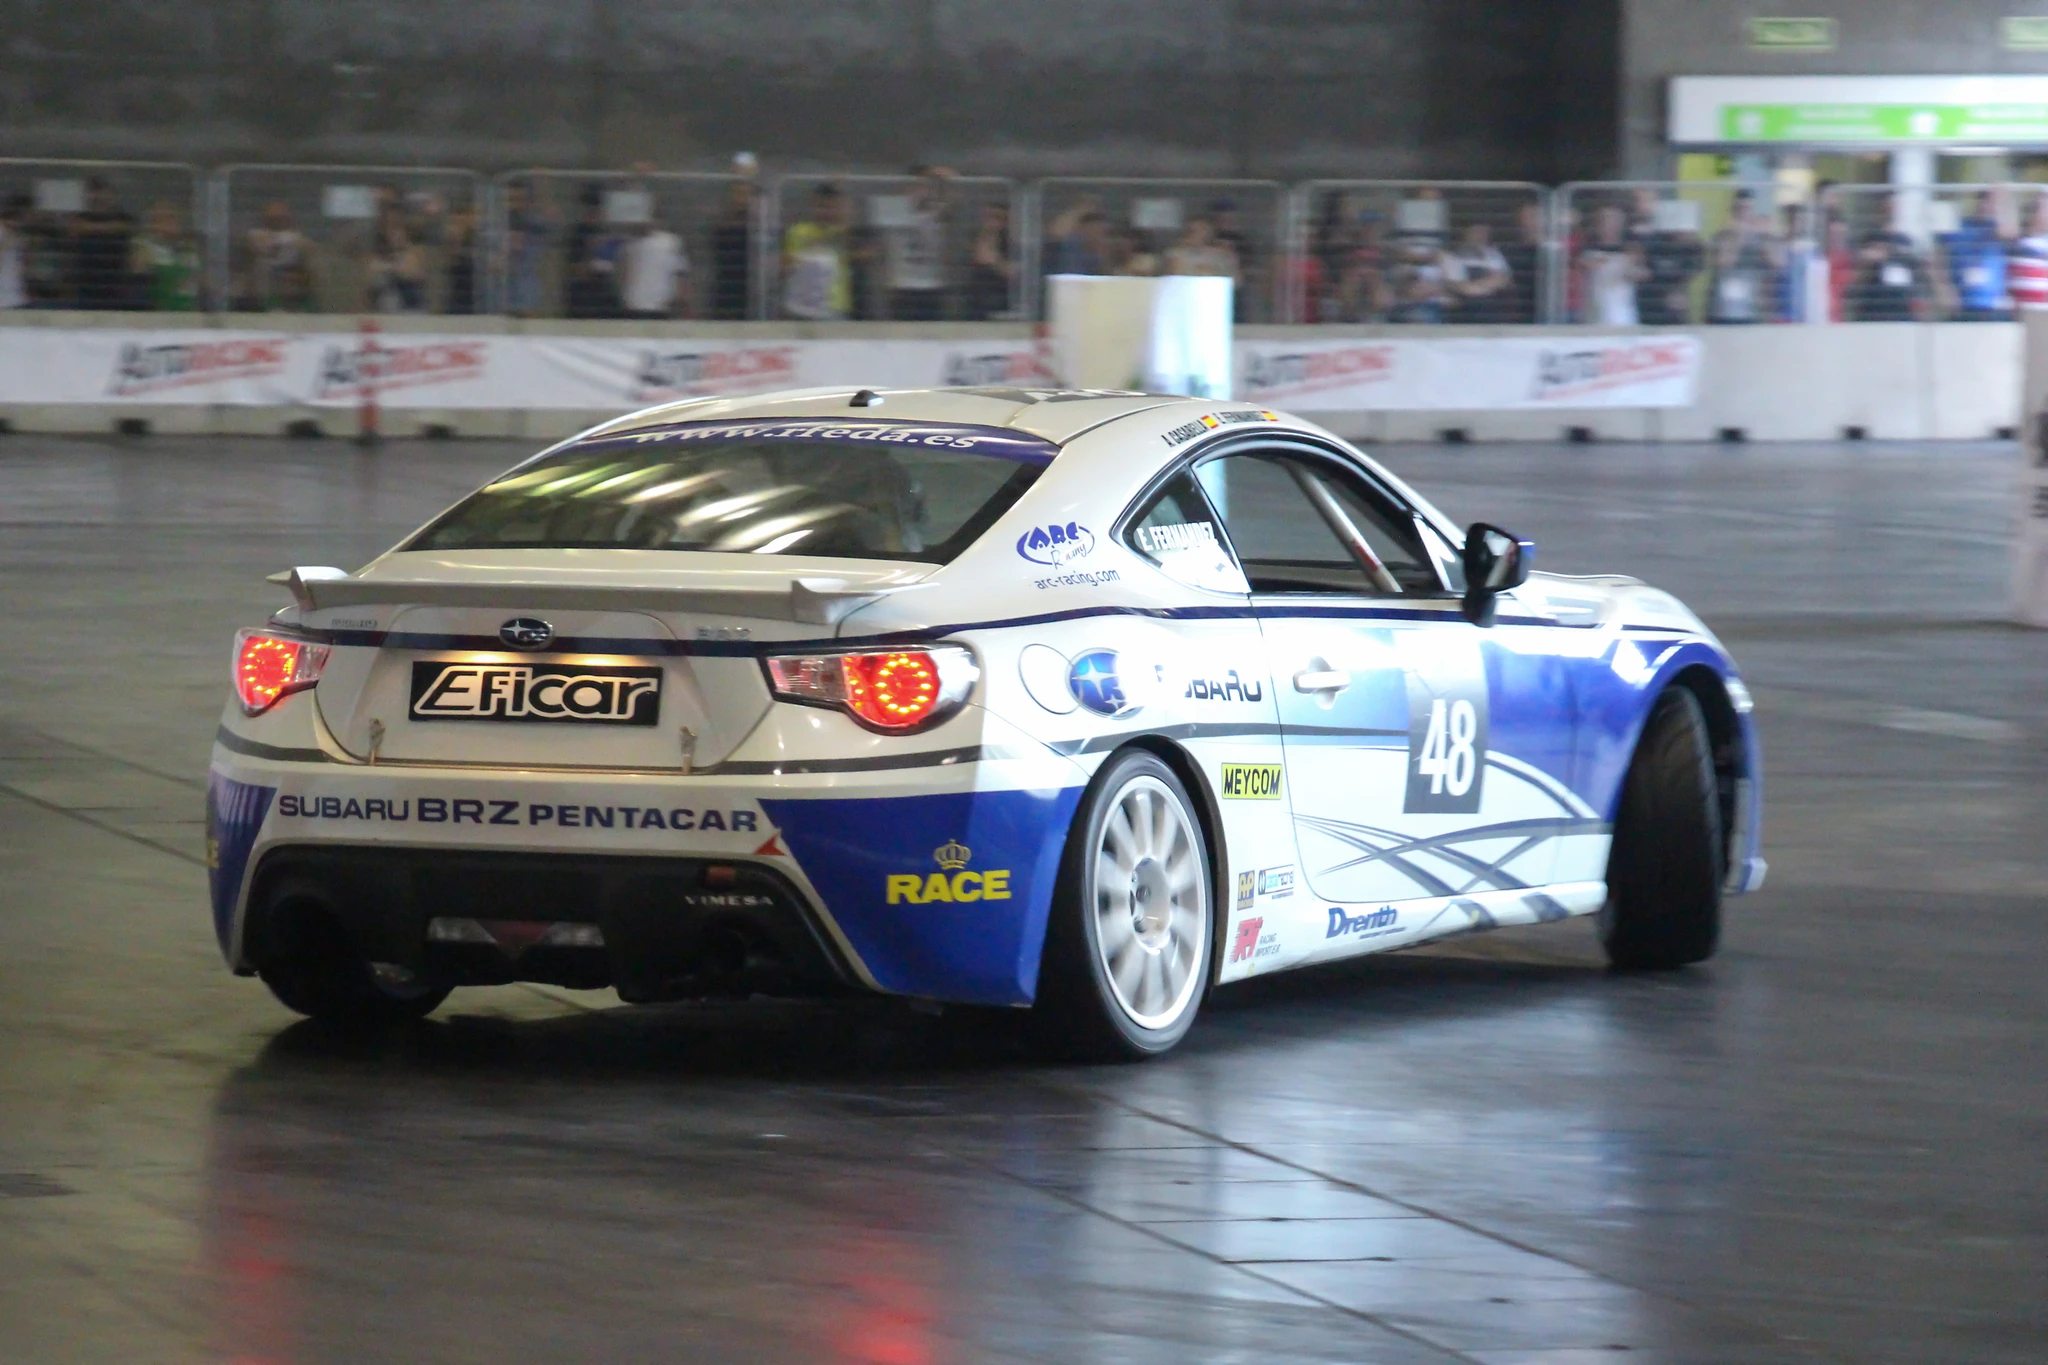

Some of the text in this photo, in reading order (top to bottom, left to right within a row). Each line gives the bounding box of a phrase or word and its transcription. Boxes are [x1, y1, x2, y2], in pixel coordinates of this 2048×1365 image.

[635, 424, 979, 449] www.rfeda.es
[1034, 569, 1121, 590] arc-racing.com
[1418, 699, 1478, 796] 48
[1224, 767, 1281, 795] MEYCOM
[279, 795, 758, 832] SUBARU BRZ PENTACAR
[886, 870, 1012, 905] RACE
